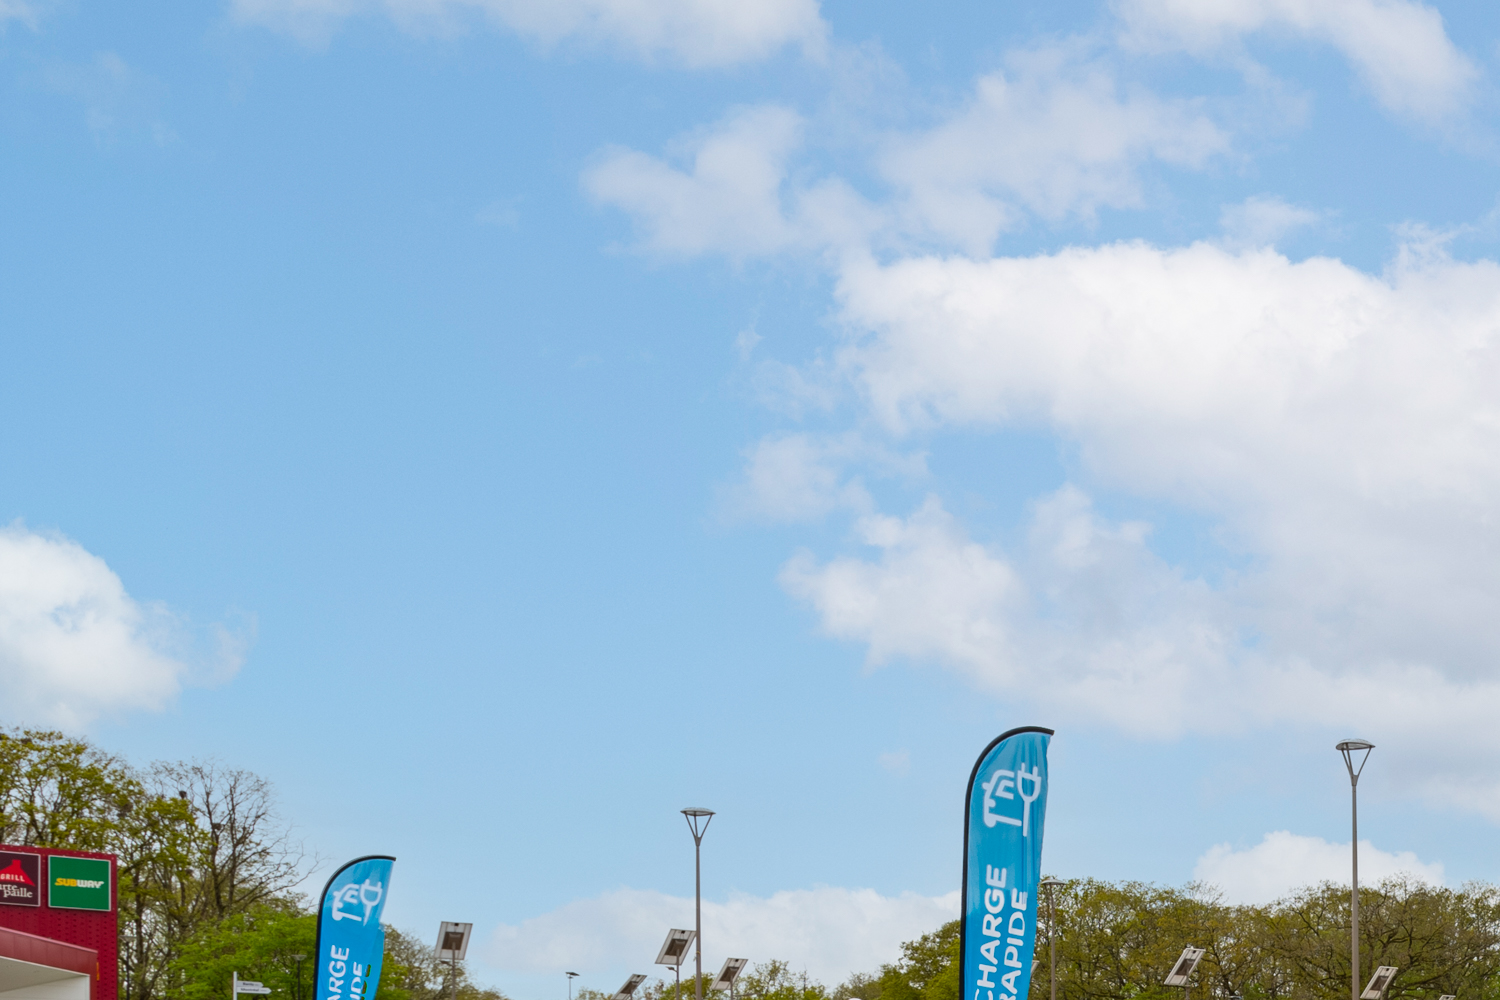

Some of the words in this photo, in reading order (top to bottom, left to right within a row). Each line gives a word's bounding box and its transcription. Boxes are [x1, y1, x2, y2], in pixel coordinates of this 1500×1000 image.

[0, 874, 25, 882] GRILL
[54, 877, 104, 889] SUBWAY
[3, 887, 33, 898] paille
